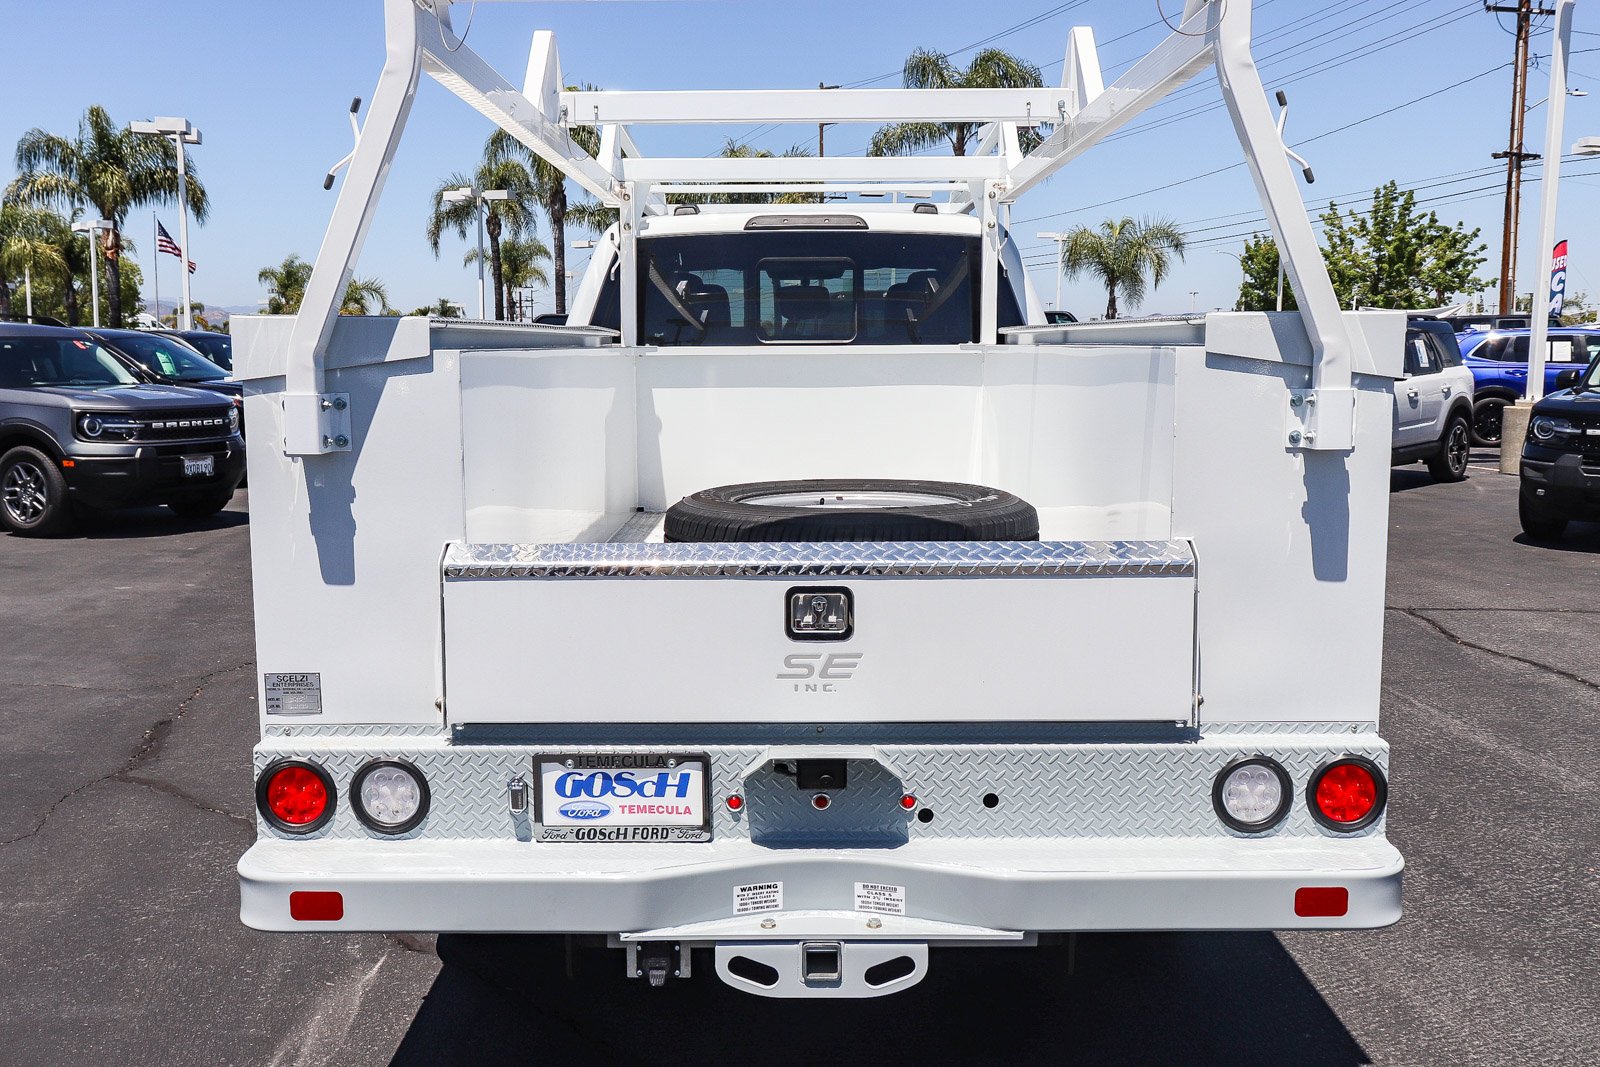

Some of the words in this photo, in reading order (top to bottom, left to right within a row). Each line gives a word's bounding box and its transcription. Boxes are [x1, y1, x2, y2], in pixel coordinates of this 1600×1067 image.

[152, 419, 223, 429] BRONCO
[776, 652, 864, 679] SE
[794, 684, 837, 692] INC.
[576, 755, 666, 768] TEMECULA
[567, 805, 602, 818] Ford
[619, 804, 692, 815] TEMECULA
[541, 829, 568, 840] Ford
[632, 827, 669, 839] FORD
[676, 828, 703, 839] Ford
[740, 883, 778, 893] WARNING
